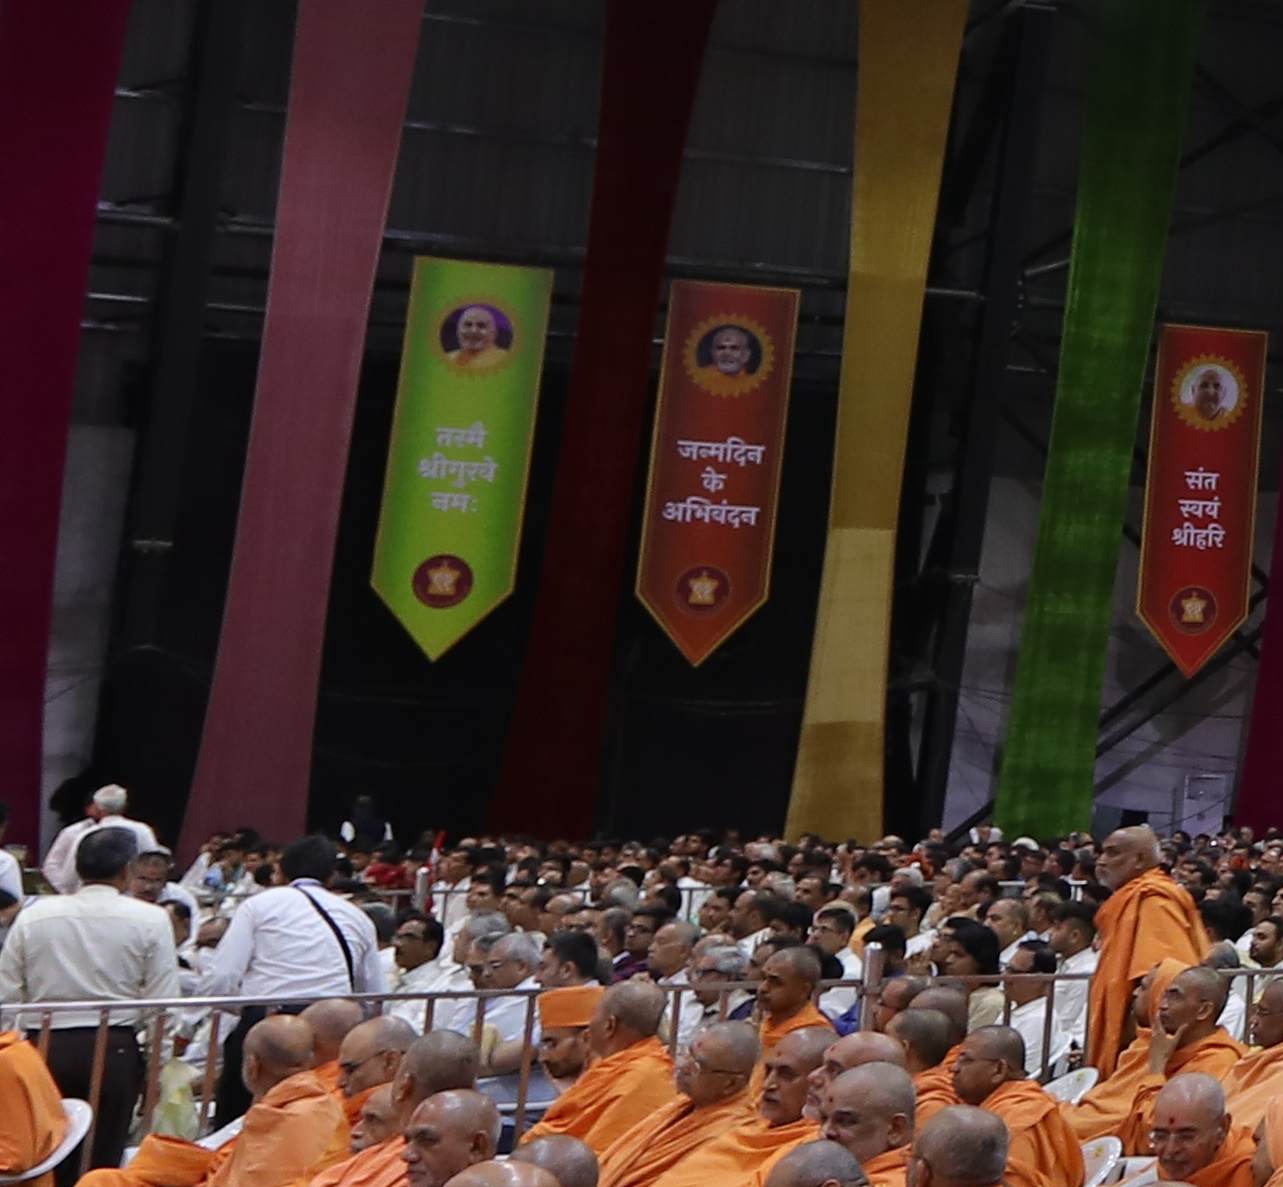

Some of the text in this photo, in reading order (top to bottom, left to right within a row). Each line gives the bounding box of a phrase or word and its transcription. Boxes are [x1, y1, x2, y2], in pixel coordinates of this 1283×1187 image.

[435, 421, 489, 449] तस्मै
[677, 437, 765, 468] जन्मदिन
[417, 454, 500, 489] श्रीगुरवे
[701, 468, 727, 493] के
[1184, 468, 1219, 491] संत
[431, 489, 478, 514] नमः
[661, 498, 760, 528] अभिवंदन
[1179, 496, 1221, 521] स्वयं
[1171, 525, 1226, 549] श्रीहरि
